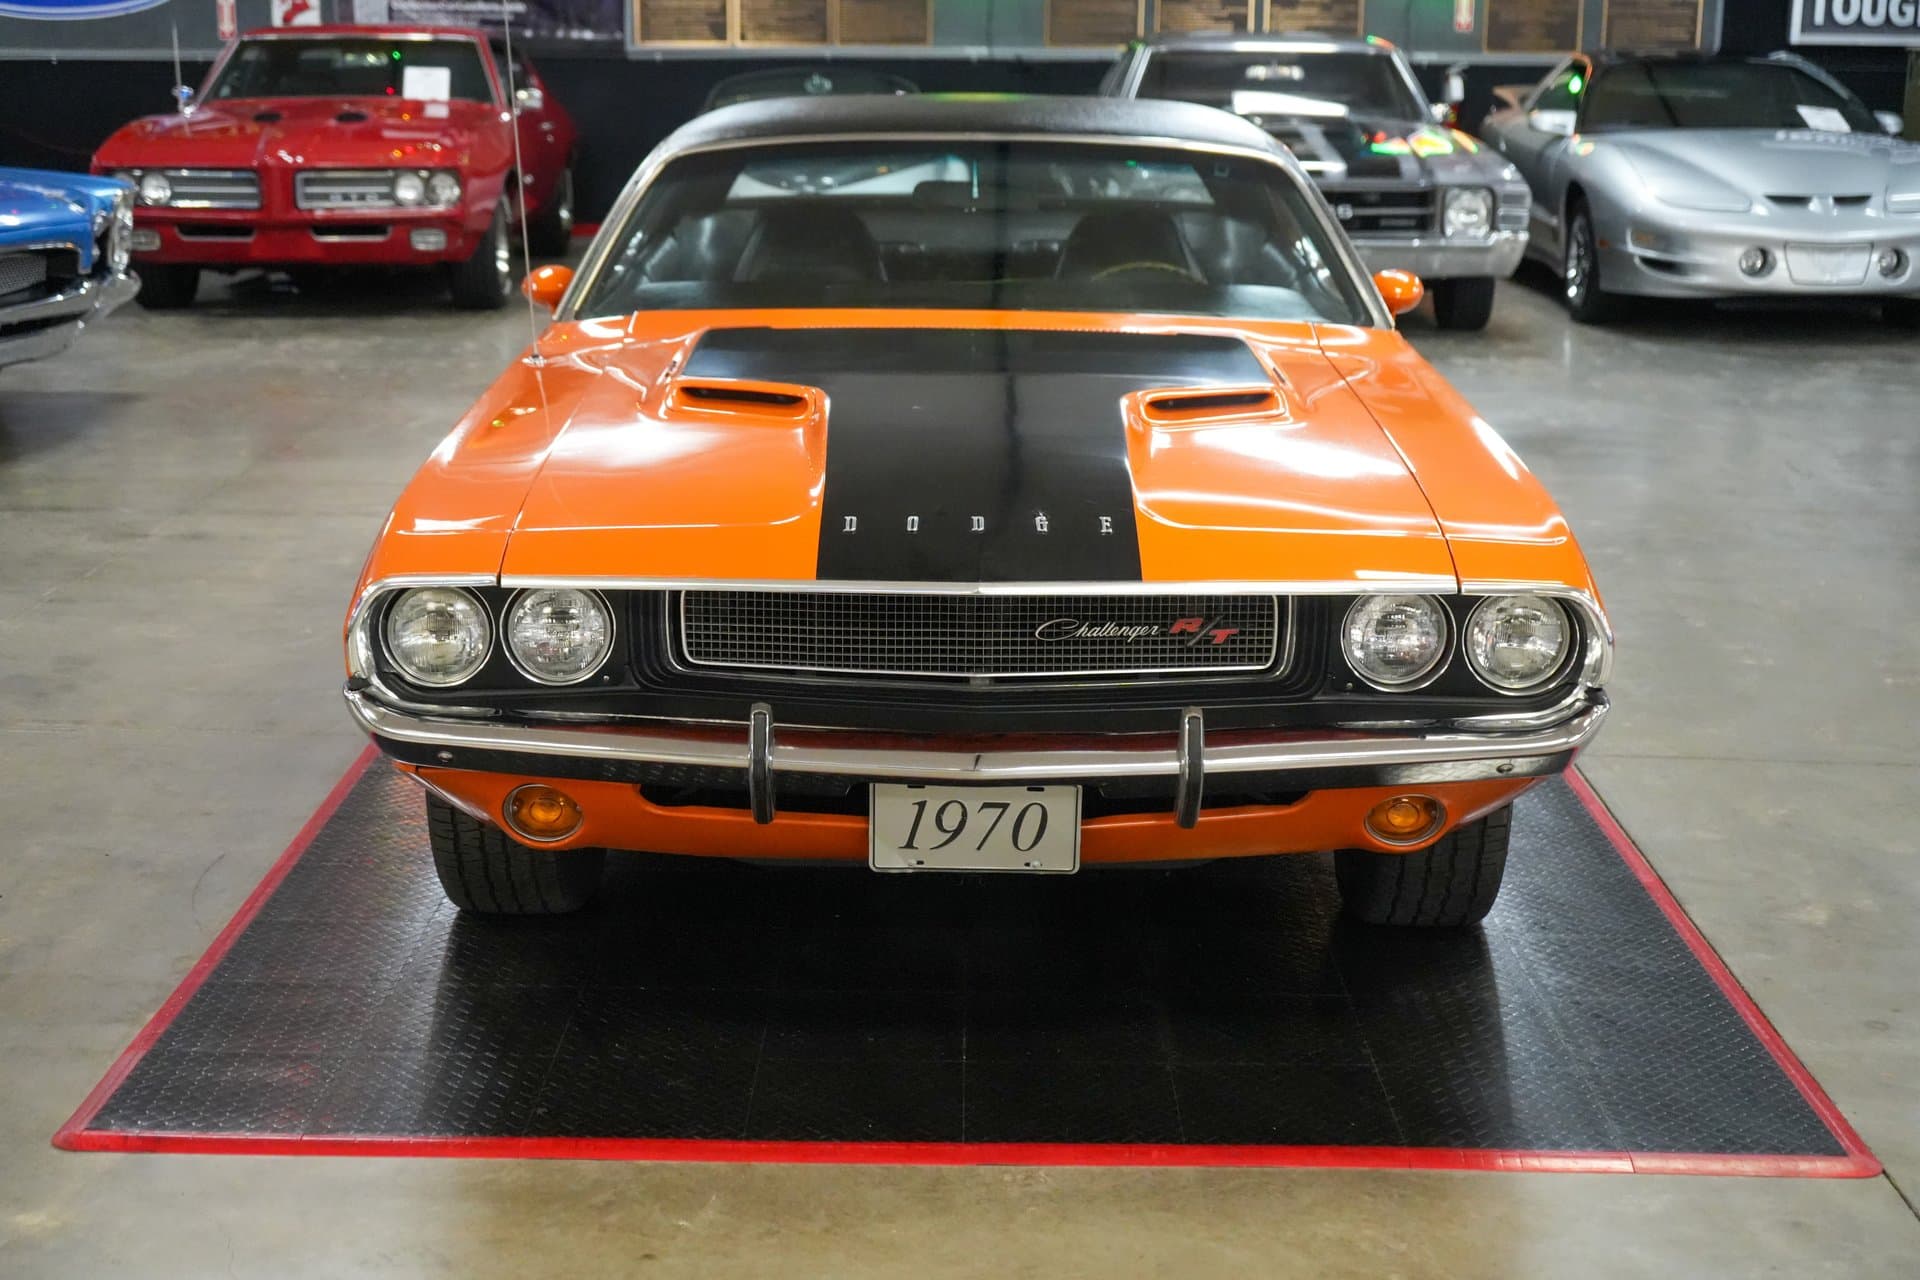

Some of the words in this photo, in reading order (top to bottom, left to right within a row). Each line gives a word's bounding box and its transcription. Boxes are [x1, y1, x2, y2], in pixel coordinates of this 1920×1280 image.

[1814, 0, 1920, 27] TOUG
[842, 514, 1113, 534] DODGE
[1035, 617, 1160, 643] Challenger
[1169, 615, 1240, 647] R/T
[898, 799, 1049, 852] 1970
